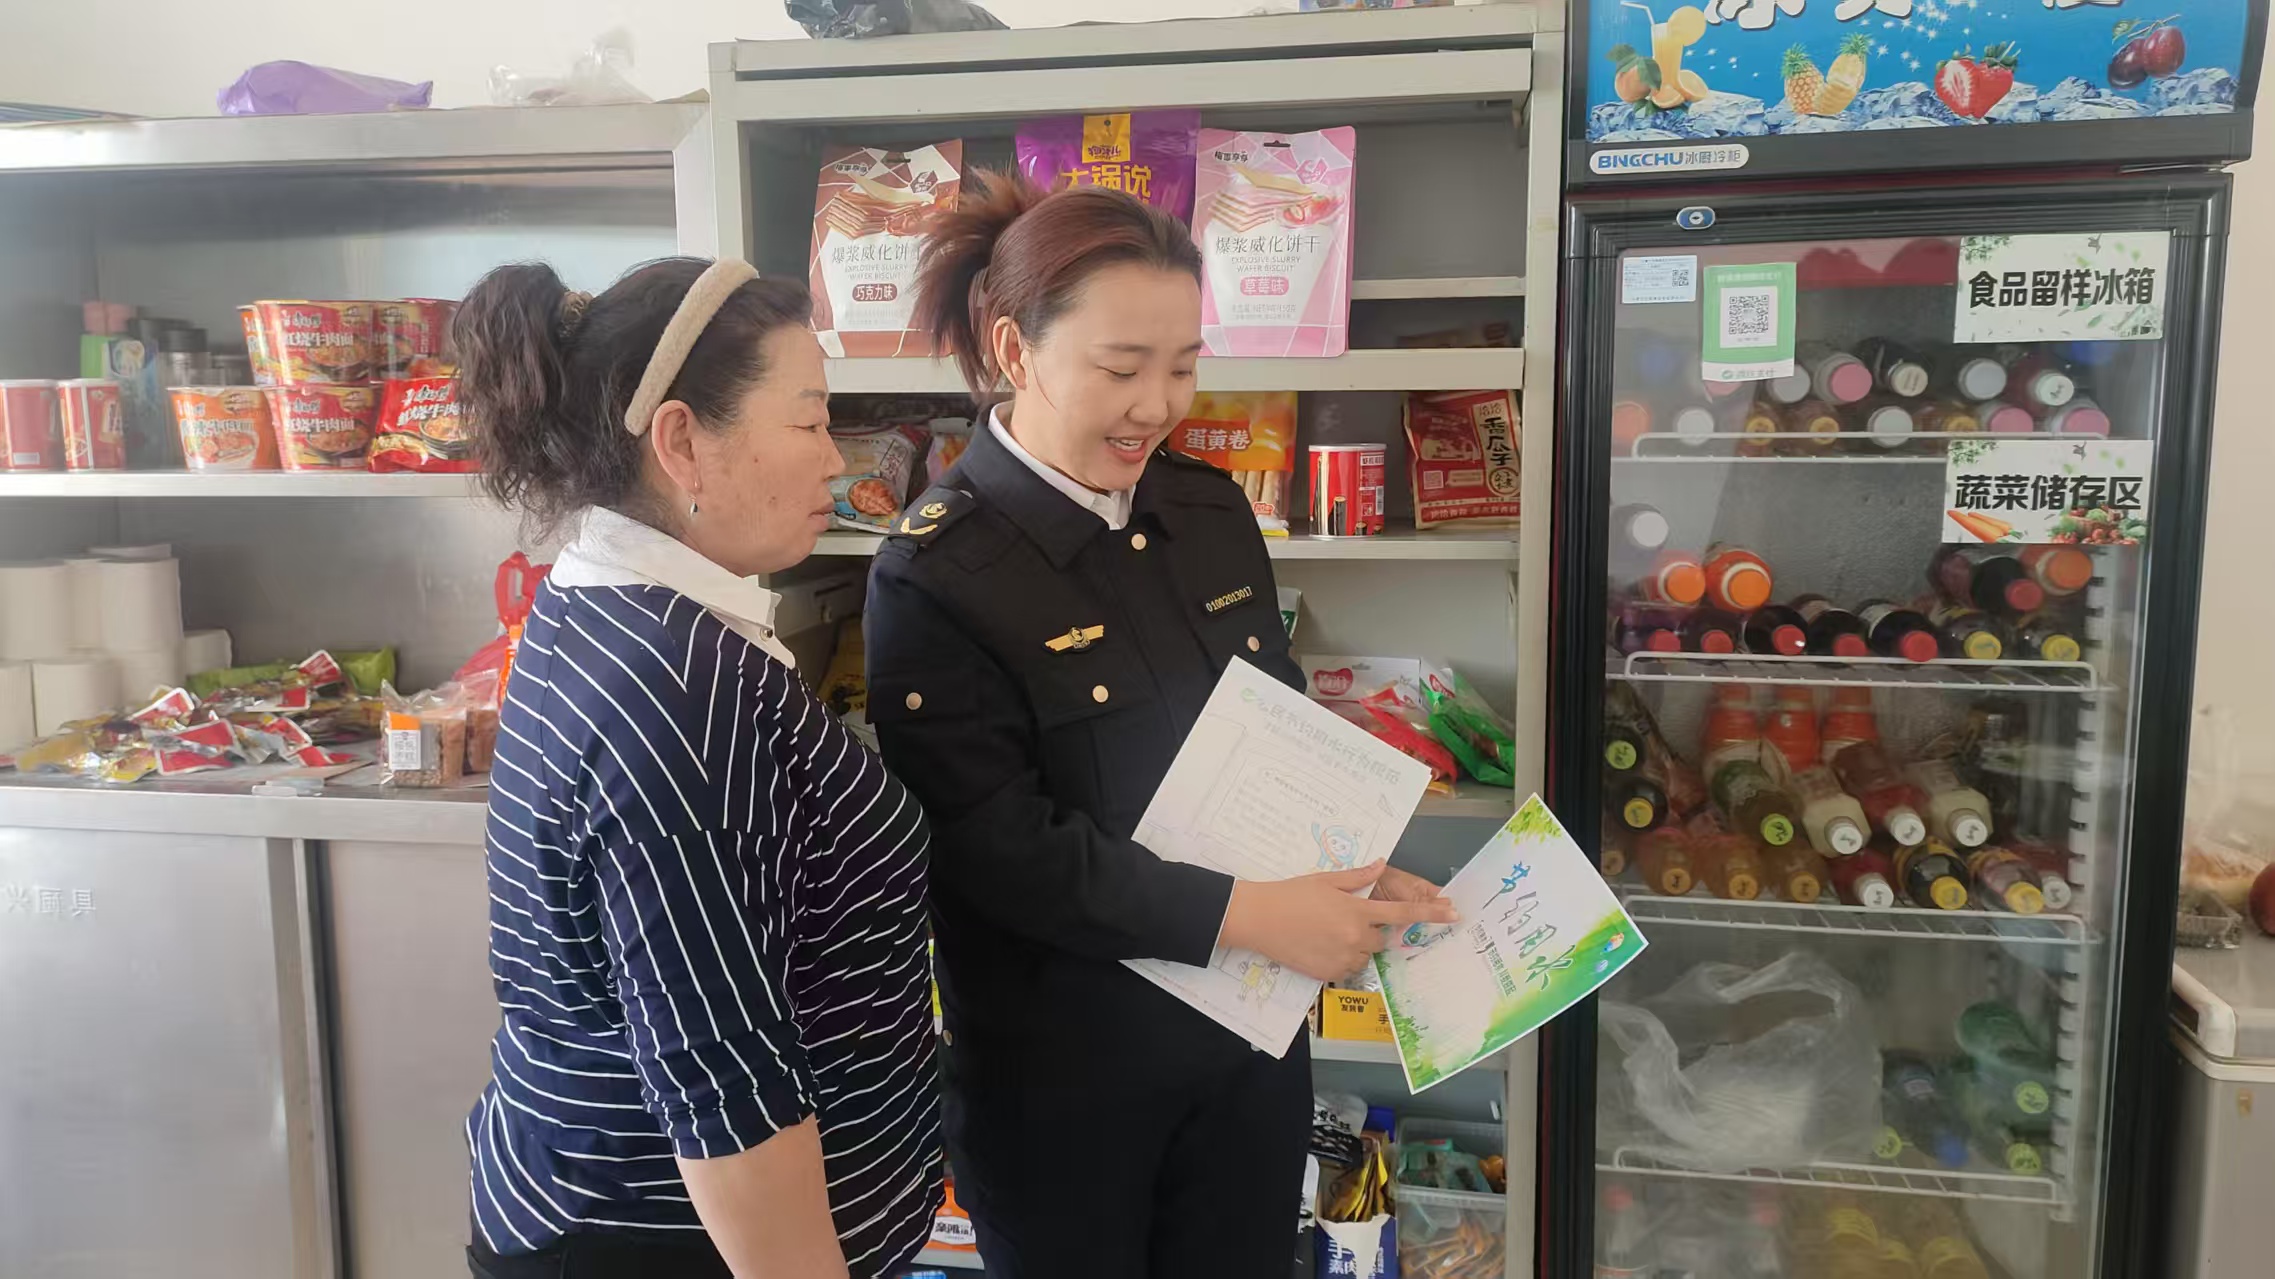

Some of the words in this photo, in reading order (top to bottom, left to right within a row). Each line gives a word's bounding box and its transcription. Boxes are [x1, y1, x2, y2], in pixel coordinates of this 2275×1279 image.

[1598, 152, 1683, 169] BINGCHU
[1215, 235, 1321, 255] 爆浆威化饼干
[855, 286, 893, 301] 巧克力味
[1243, 278, 1285, 294] 草莓味
[1968, 268, 2155, 307] 食品留样冰箱
[397, 402, 462, 427] 红烧牛肉
[1183, 428, 1250, 451] 蛋黄卷
[1954, 474, 2143, 511] 蔬菜储存区
[1205, 585, 1253, 612] 01002013017
[1338, 995, 1369, 1005] YOWU
